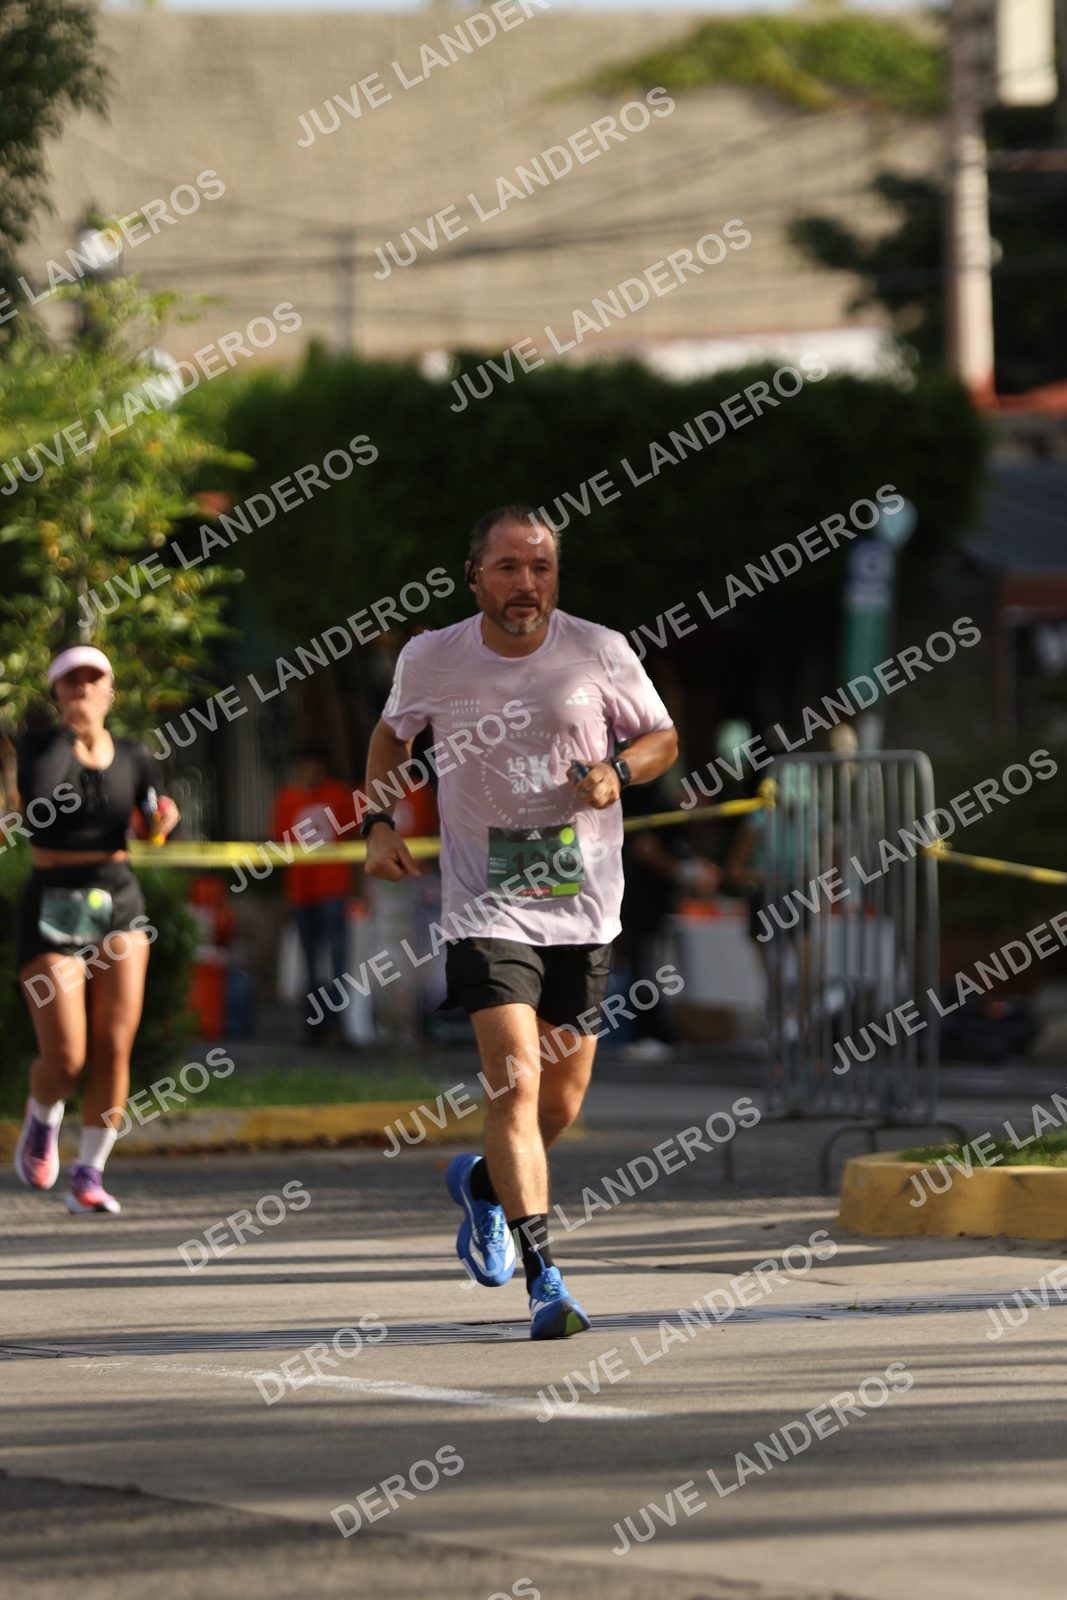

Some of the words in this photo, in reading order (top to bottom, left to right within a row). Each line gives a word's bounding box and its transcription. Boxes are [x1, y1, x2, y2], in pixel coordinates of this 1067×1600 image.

[506, 757, 525, 773] 15
[529, 754, 557, 794] K
[511, 778, 529, 795] 30
